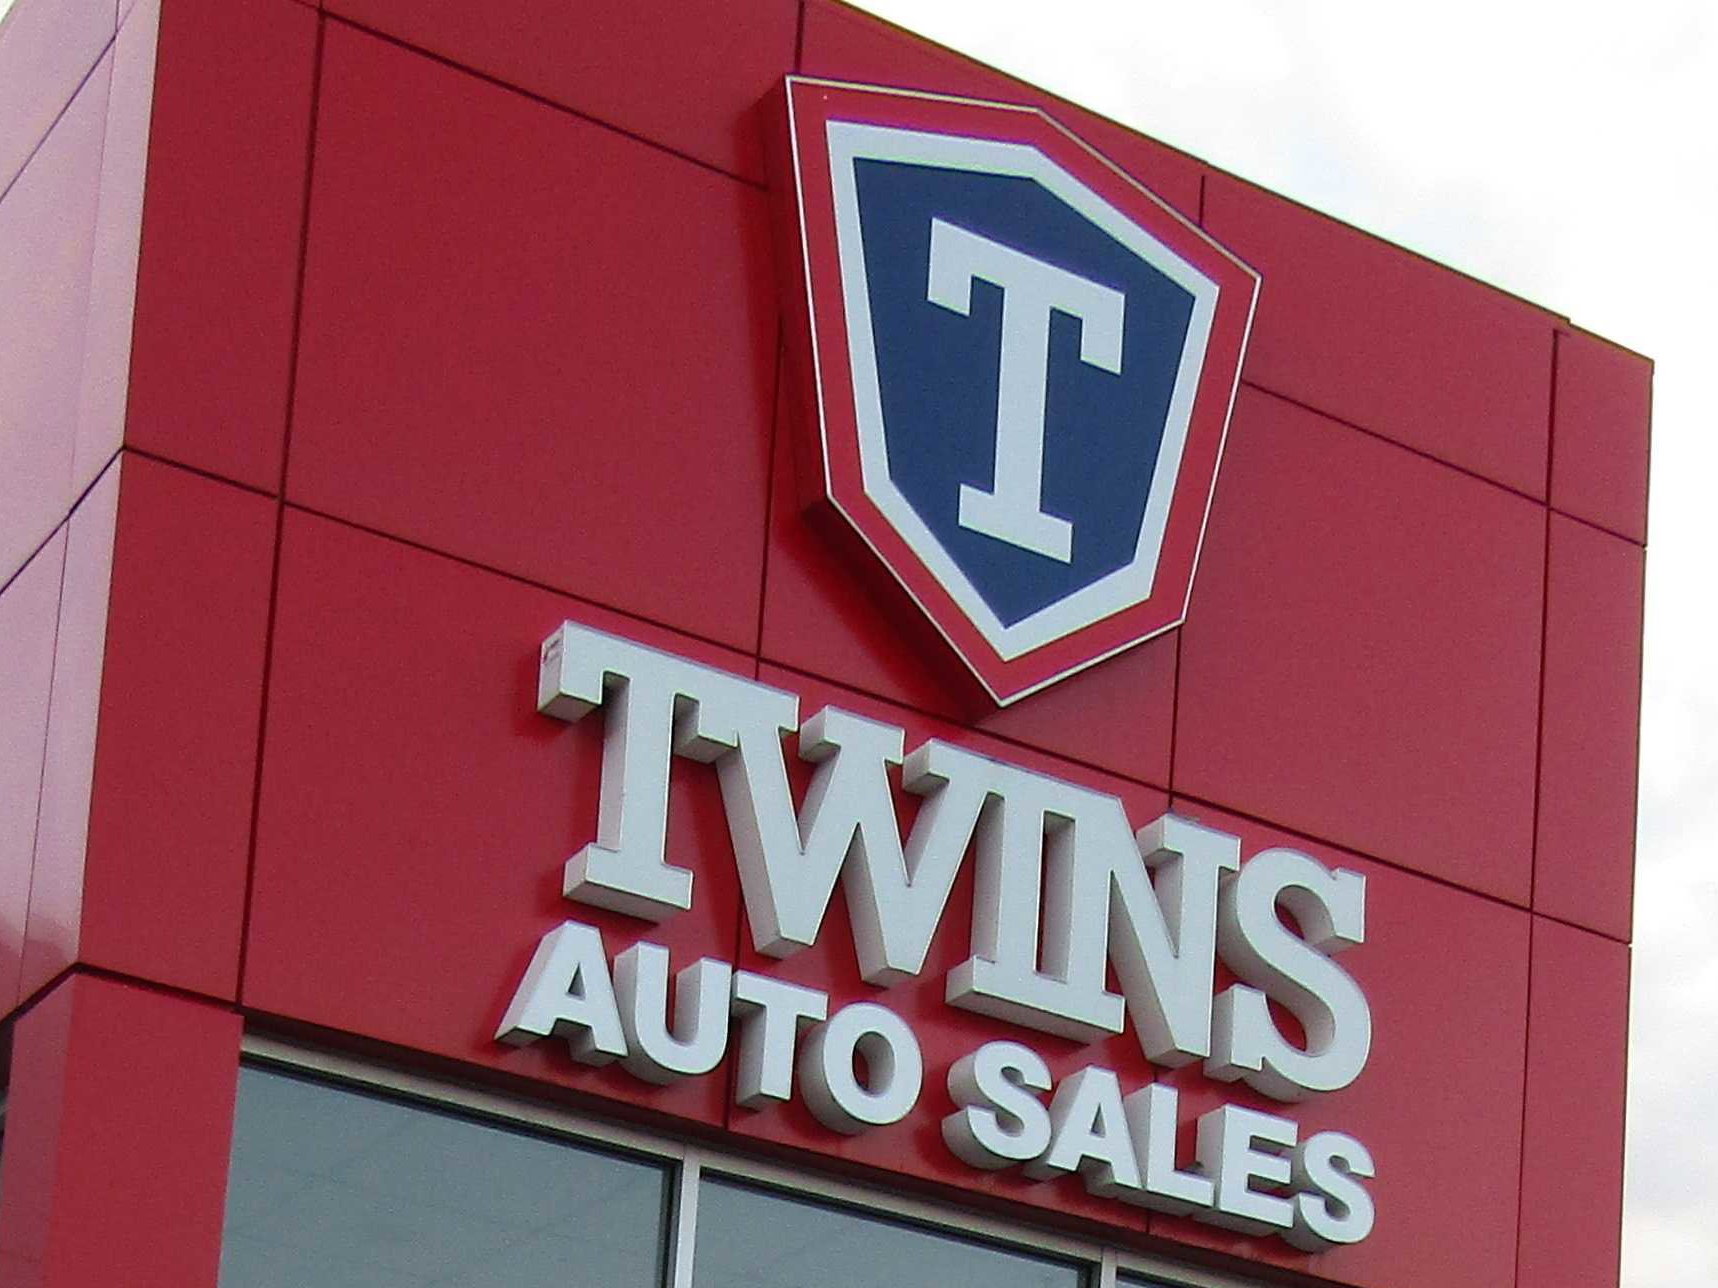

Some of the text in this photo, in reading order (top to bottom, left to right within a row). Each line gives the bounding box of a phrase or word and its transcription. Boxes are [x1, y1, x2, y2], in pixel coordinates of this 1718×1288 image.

[927, 216, 1125, 564] T
[538, 619, 1372, 1102] TWINS
[495, 918, 1375, 1253] AUTO SALES
